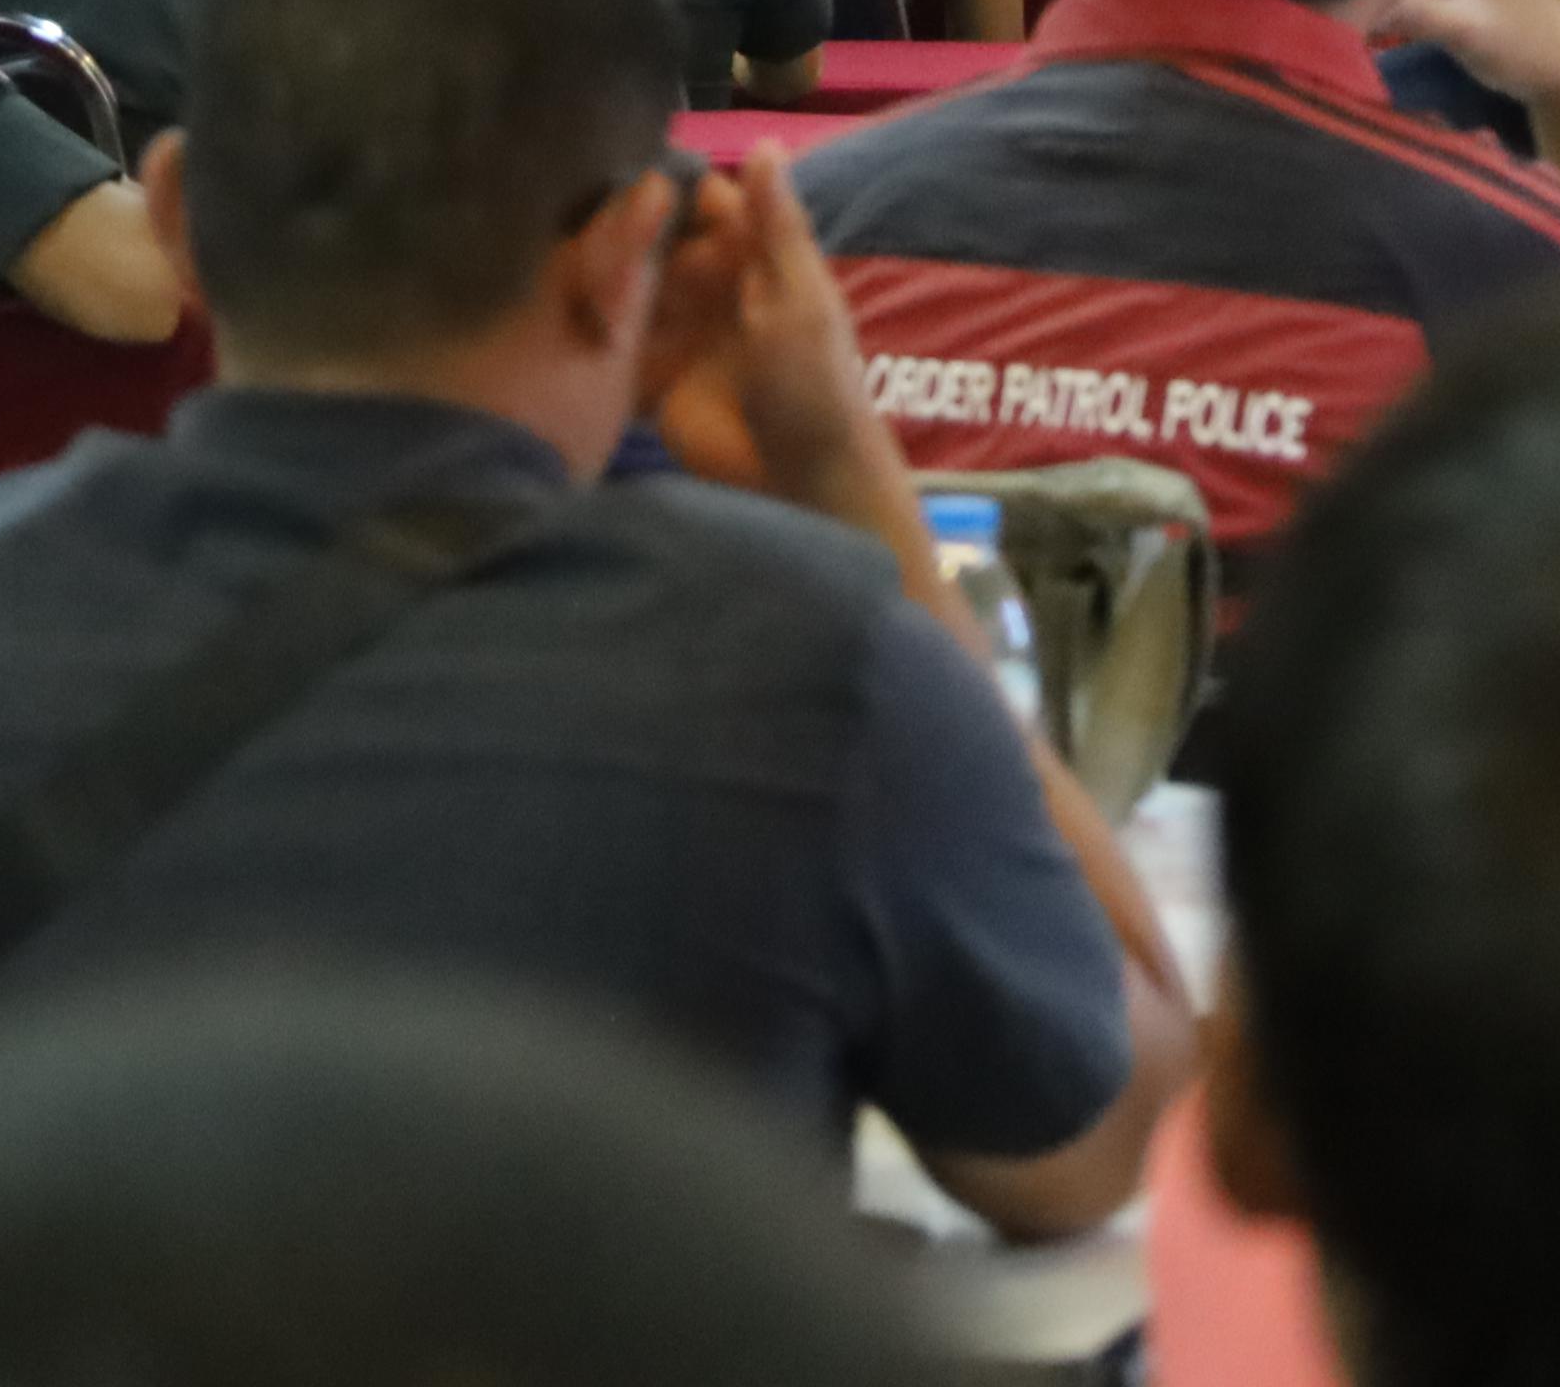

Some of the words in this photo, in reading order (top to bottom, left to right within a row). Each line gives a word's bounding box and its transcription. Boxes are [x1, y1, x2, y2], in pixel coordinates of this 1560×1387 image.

[865, 354, 991, 423] ORDER
[999, 363, 1152, 439] PATROL
[1161, 379, 1313, 461] POLICE
